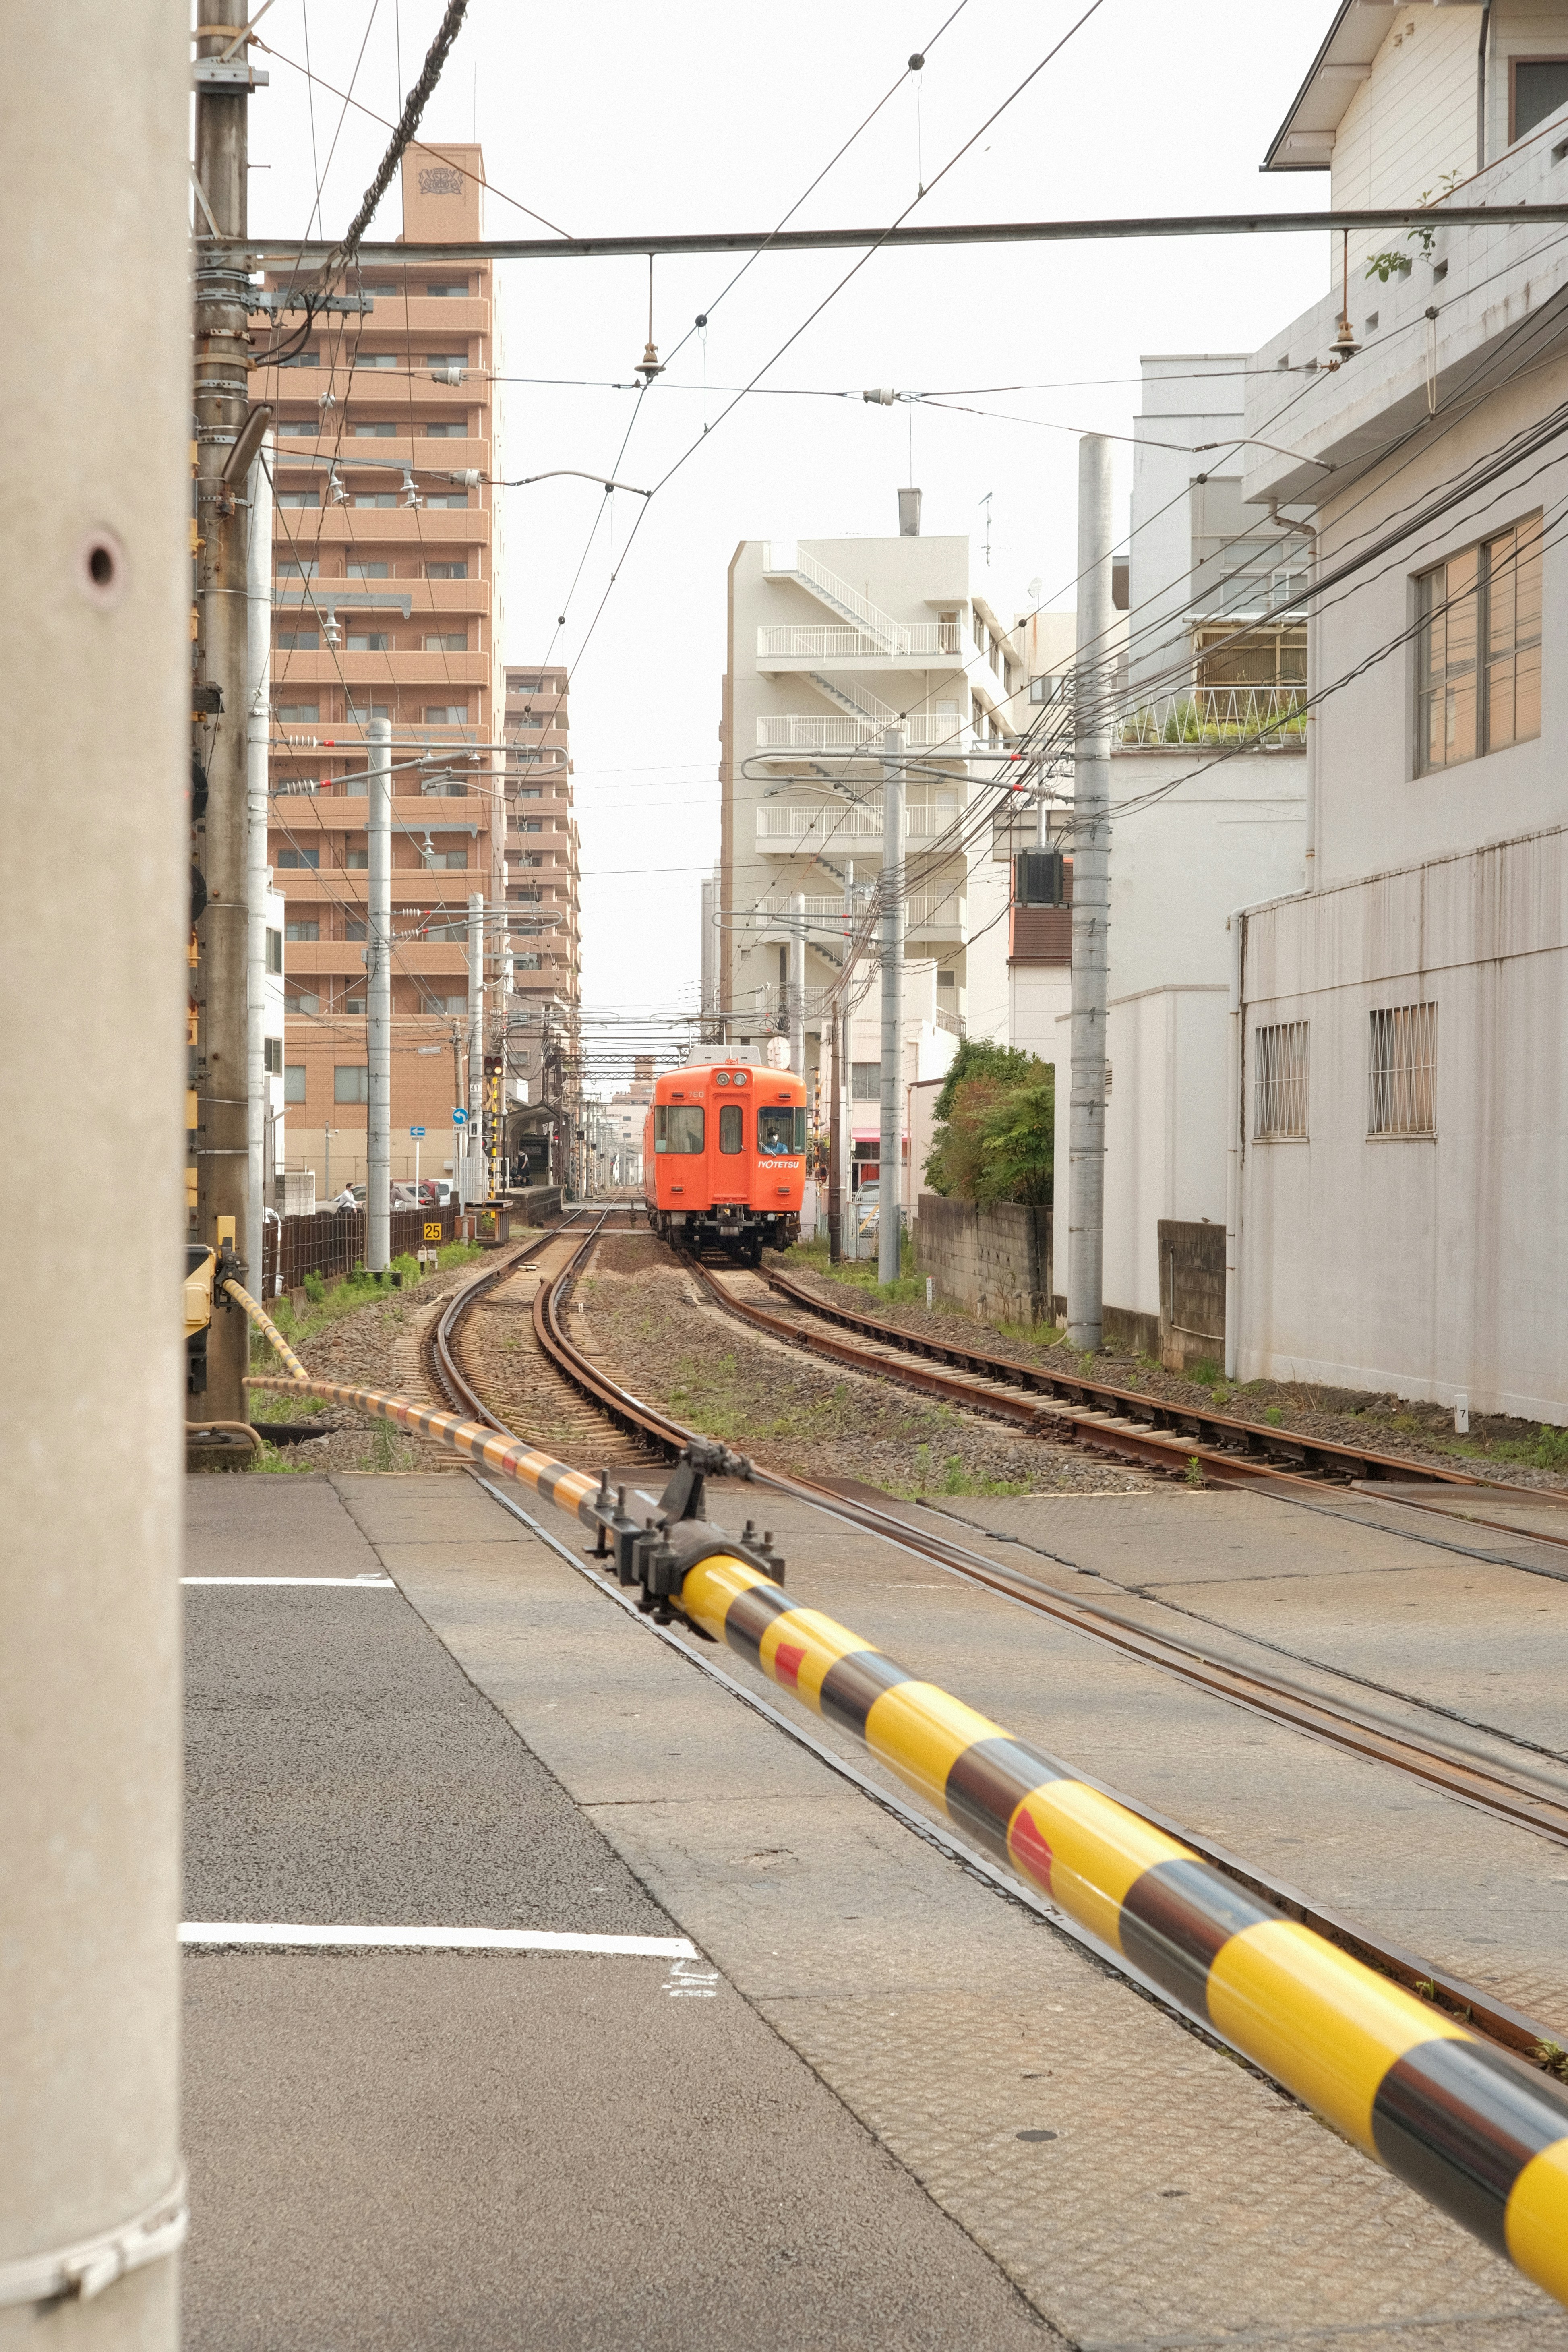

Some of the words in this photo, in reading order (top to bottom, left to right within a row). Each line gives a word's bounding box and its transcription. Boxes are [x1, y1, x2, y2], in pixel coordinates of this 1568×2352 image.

[758, 1160, 799, 1169] IYOTETSU
[426, 1225, 440, 1238] 25
[1460, 1410, 1465, 1418] 7
